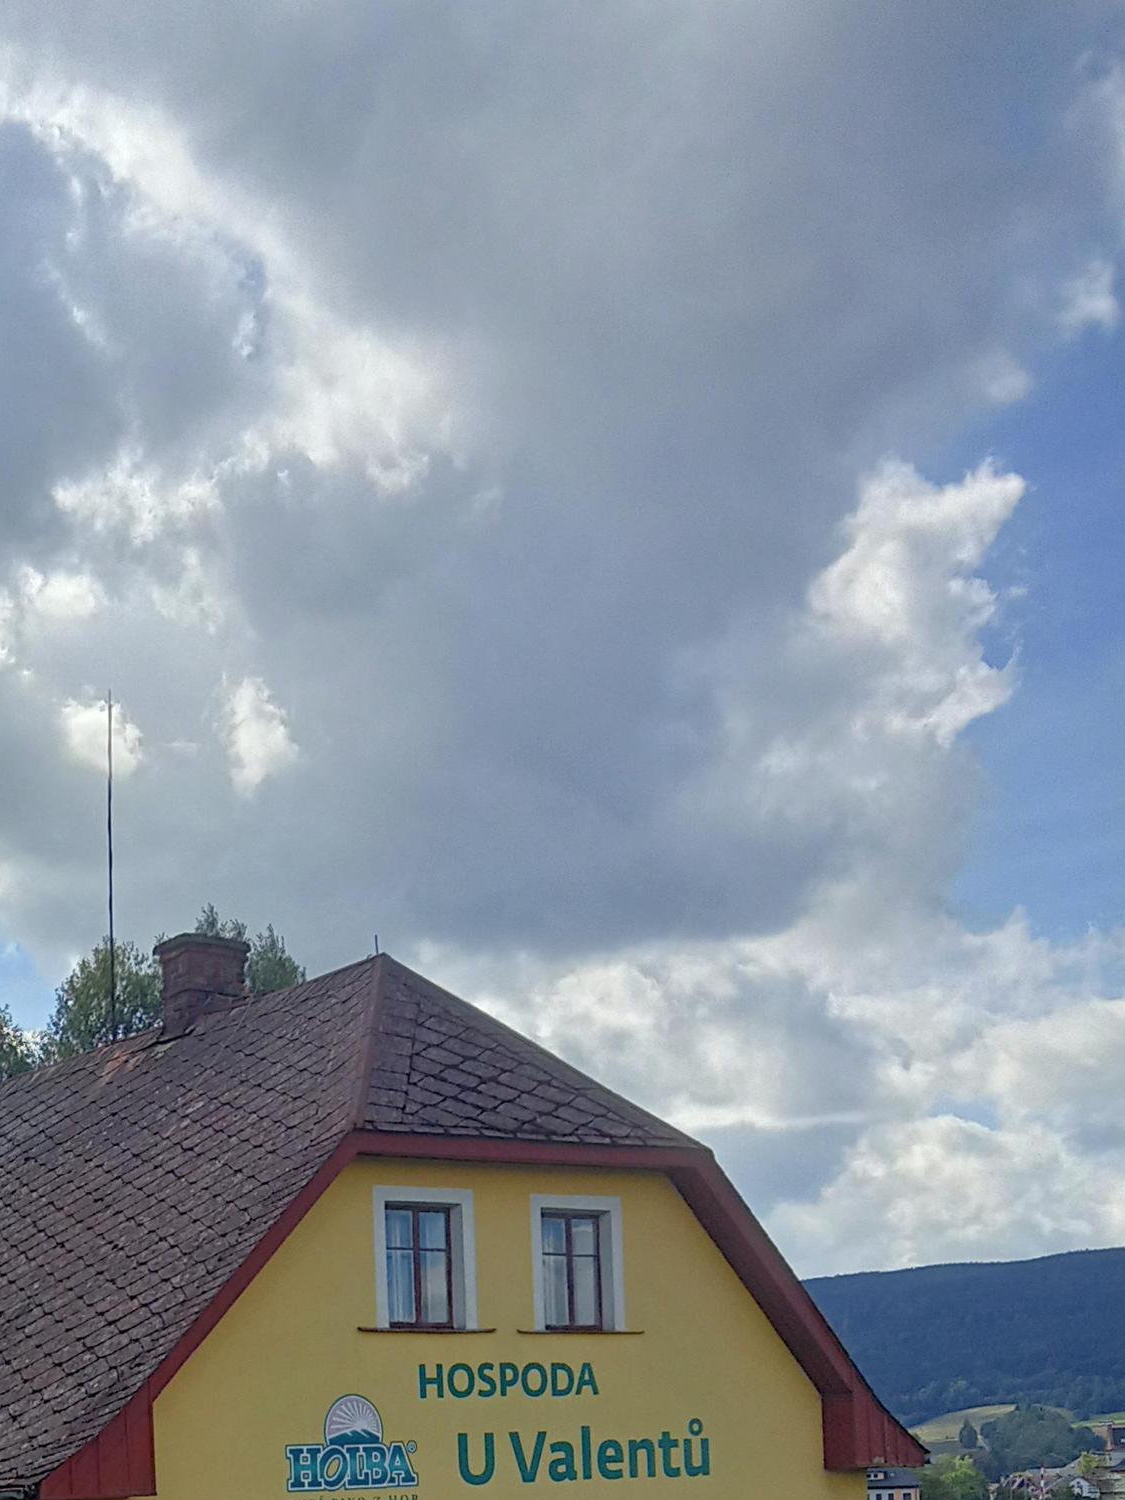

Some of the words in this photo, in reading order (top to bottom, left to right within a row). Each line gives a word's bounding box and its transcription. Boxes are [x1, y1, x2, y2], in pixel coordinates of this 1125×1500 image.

[418, 1361, 600, 1399] HOSPODA
[286, 1442, 418, 1491] HOLBA
[457, 1432, 496, 1486] U
[508, 1417, 711, 1484] Valentů
